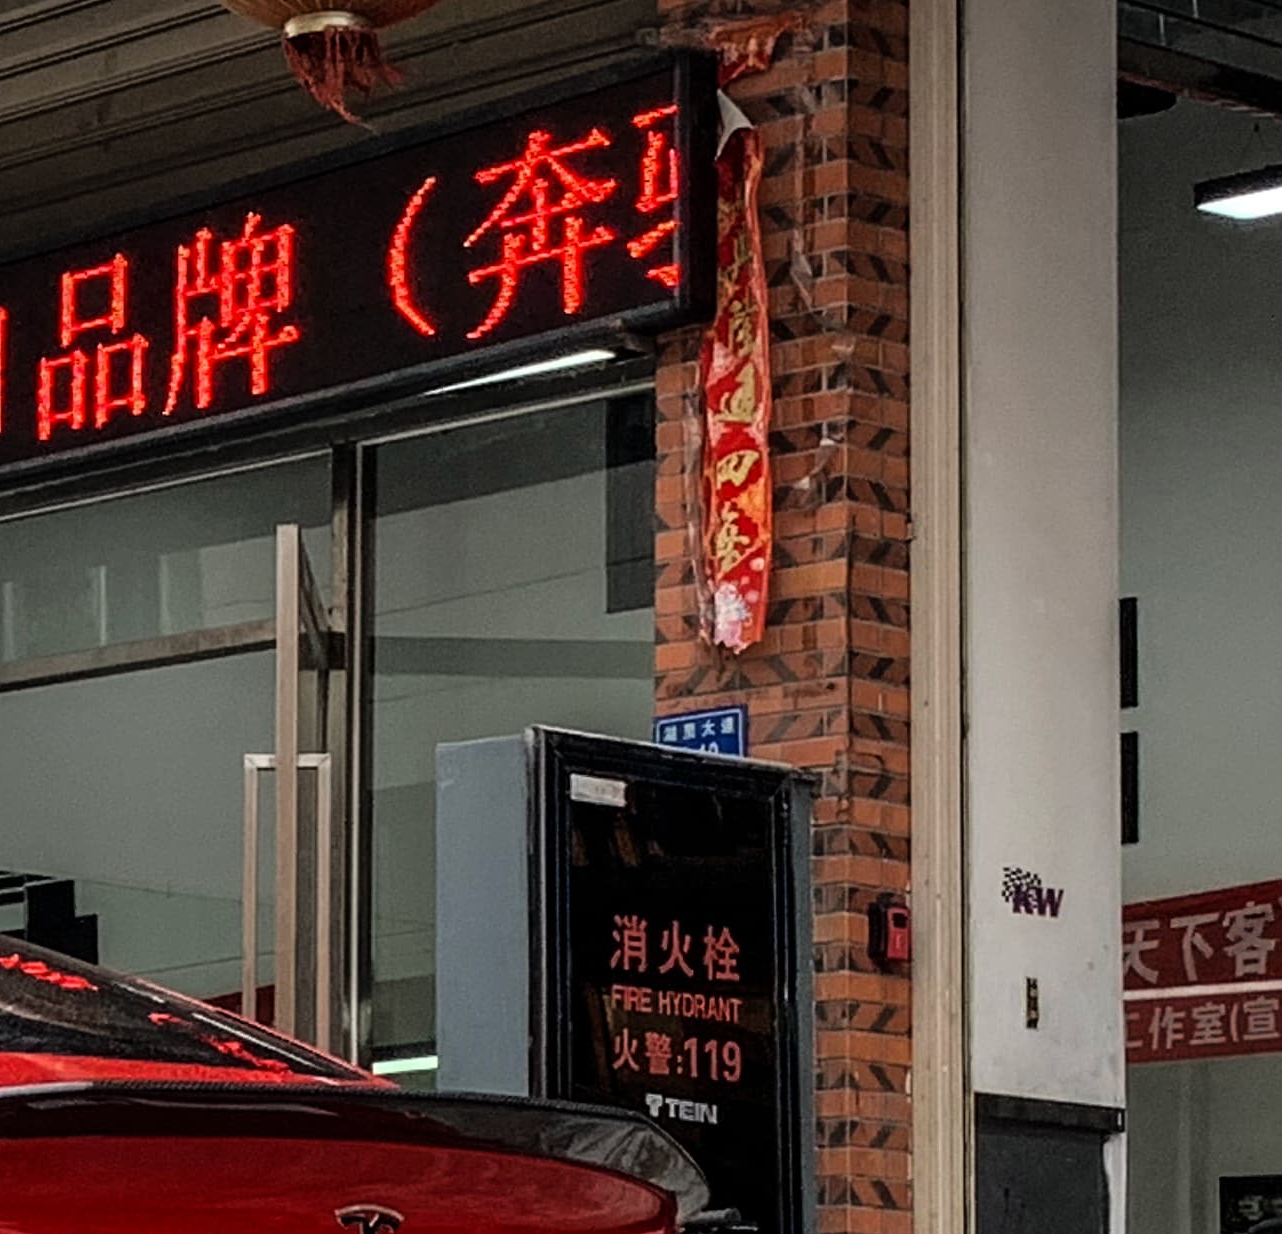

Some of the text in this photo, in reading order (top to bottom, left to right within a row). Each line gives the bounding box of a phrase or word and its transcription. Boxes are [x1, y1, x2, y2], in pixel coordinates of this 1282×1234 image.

[610, 914, 740, 982] 消火栓
[1122, 900, 1282, 985] 天下客
[611, 984, 742, 1024] FIRE HYDRANT
[665, 1097, 719, 1125] TEIN
